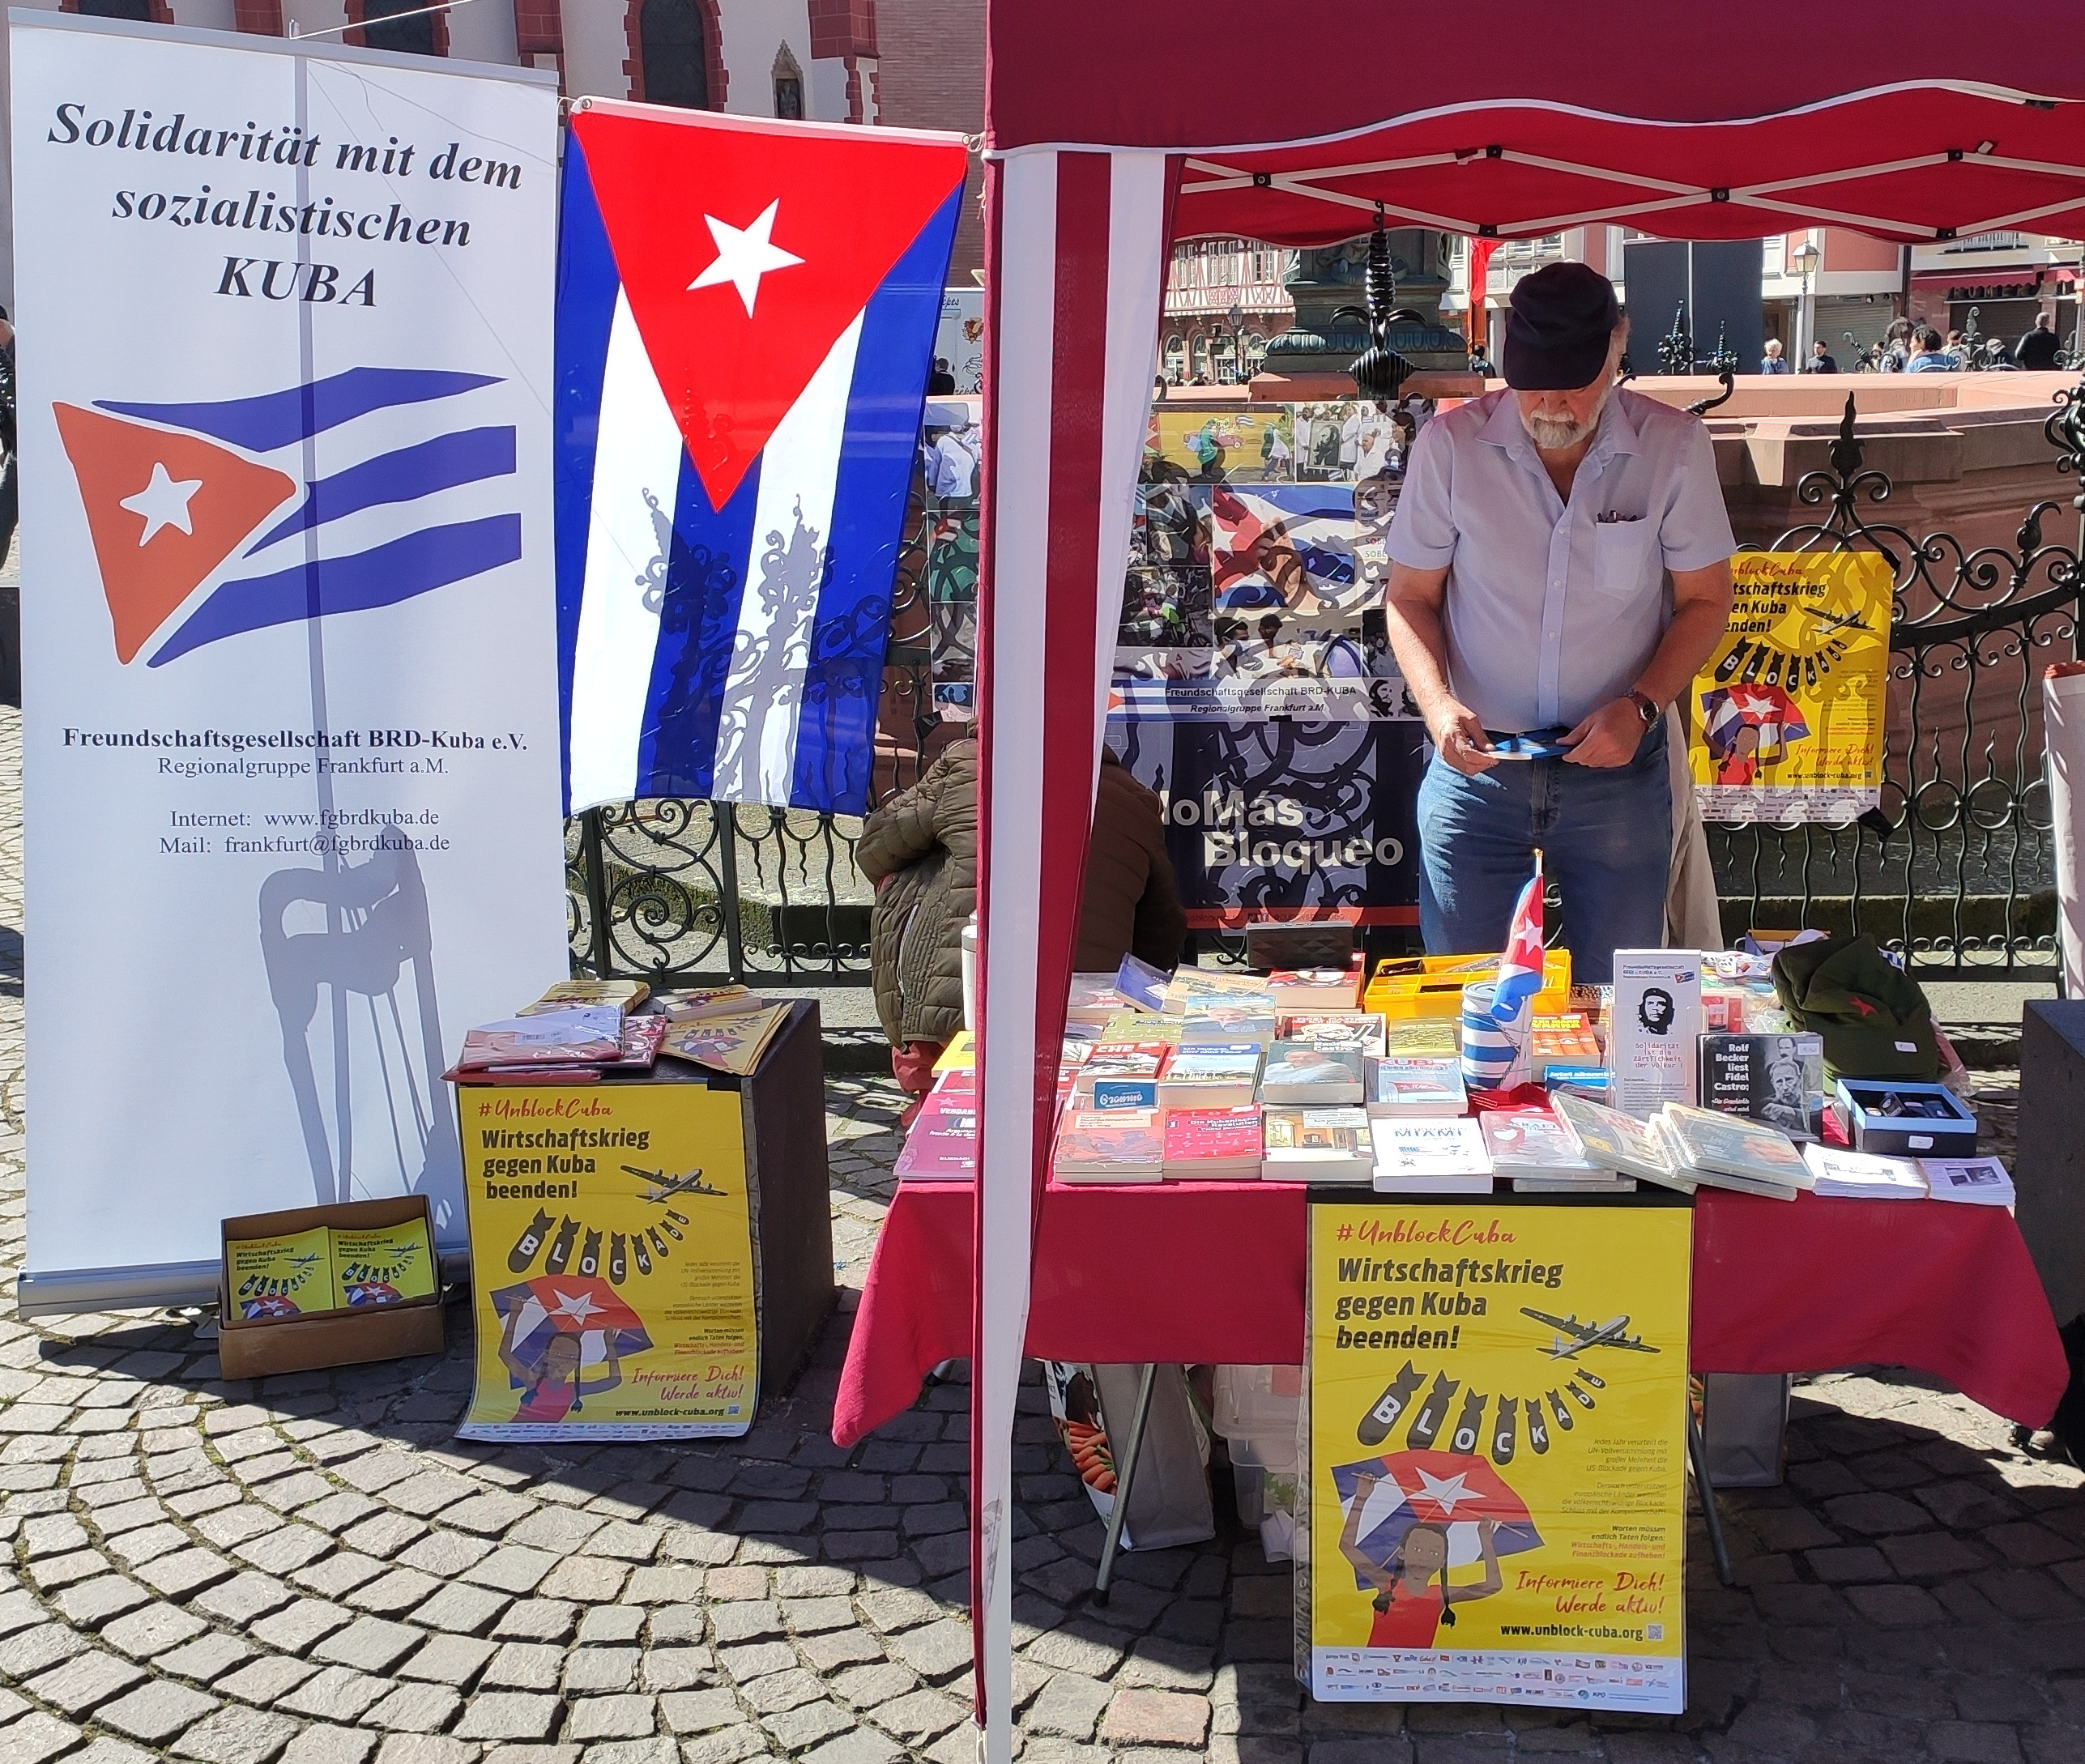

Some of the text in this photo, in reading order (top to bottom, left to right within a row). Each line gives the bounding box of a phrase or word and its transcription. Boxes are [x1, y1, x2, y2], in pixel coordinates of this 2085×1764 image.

[47, 103, 522, 189] Solidarität mit dem
[112, 184, 471, 246] sozialistischen
[213, 255, 377, 307] KUBA
[1733, 582, 1826, 597] tschaftskrieg
[1751, 600, 1786, 614] Kuba
[1165, 685, 1356, 698] Freundschaftsgesellschaft BRD-KUBA
[1190, 704, 1306, 714] Regionalgruppe Frankfurt
[62, 728, 528, 751] Freundschaftsgesellschaft BRD-Kuba e.V.
[1845, 743, 1874, 754] Dich!
[158, 757, 449, 777] Regionalgruppe Frankfurt a.M.
[170, 809, 440, 829] Internet: www.fgbrdkuba.de
[159, 834, 450, 855] Mail: frankfurt@fgbrdkuba.de
[1205, 831, 1404, 875] Bloqueo
[1715, 1053, 1750, 1062] Becker
[1729, 1044, 1750, 1052] Rolf
[1725, 1072, 1750, 1081] Fidel
[1728, 1063, 1750, 1072] liest
[1714, 1082, 1750, 1091] Castro:
[478, 1097, 613, 1119] #UnblockCuba
[481, 1127, 650, 1151] Wirtschaftskrieg
[483, 1153, 596, 1178] gegen Kuba
[486, 1179, 578, 1200] beenden!
[1336, 1219, 1517, 1246] #UnblockCuba
[517, 1215, 689, 1276] BLOCKADE
[1338, 1257, 1564, 1289] Wirtschaftskrieg
[1335, 1291, 1487, 1320] gegen Kuba
[1336, 1324, 1460, 1349] beenden!
[631, 1365, 744, 1387] Informiere Dich!
[661, 1385, 743, 1401] Werde aktiv!
[615, 1405, 725, 1417] www.unblock-cuba.org
[1371, 1375, 1604, 1456] BLOCKADE
[1640, 1534, 1665, 1542] folgen:
[1572, 1550, 1665, 1559] Finanzblockade aufheben!
[1516, 1570, 1665, 1593] Informiere Dich!
[1555, 1592, 1665, 1615] Werde aktiv!
[1500, 1624, 1643, 1642] www.unblock-cuba.org
